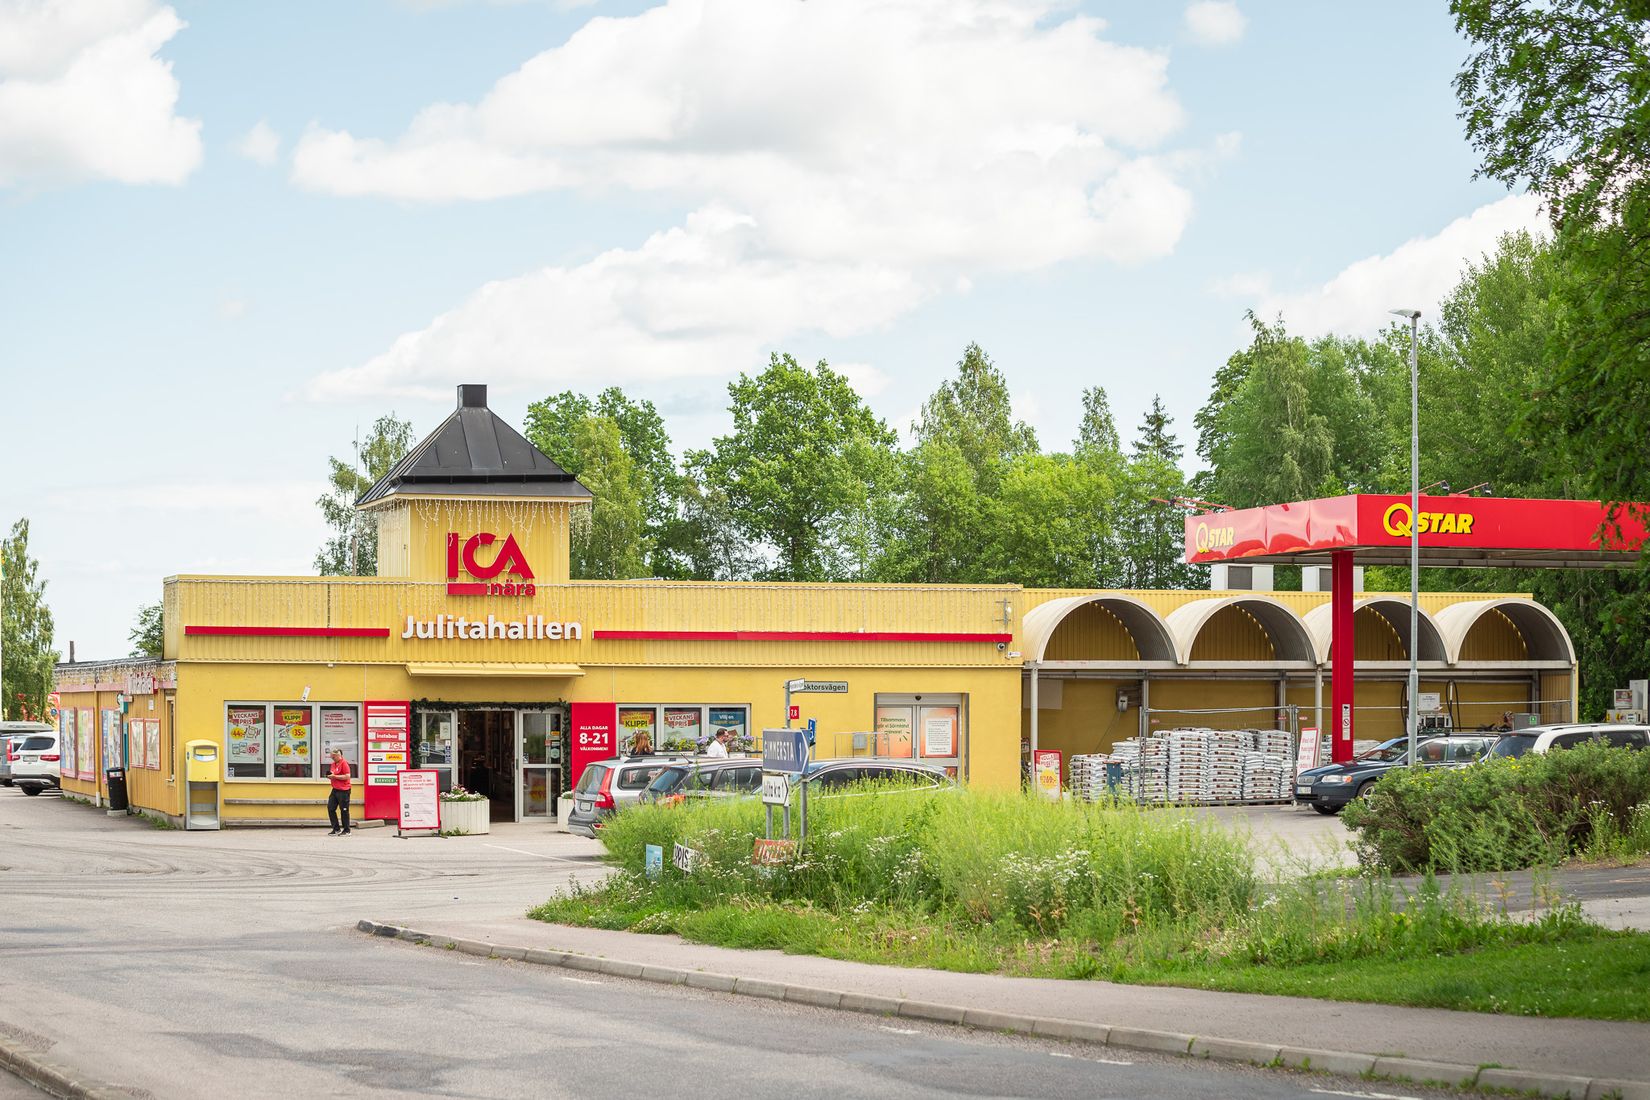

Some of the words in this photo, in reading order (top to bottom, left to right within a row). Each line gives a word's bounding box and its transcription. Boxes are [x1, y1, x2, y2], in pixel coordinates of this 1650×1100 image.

[1383, 502, 1475, 537] QSTAR
[1195, 521, 1235, 554] QSTAR
[447, 532, 535, 580] ICA
[489, 579, 536, 597] nära
[401, 614, 582, 640] Julitahallen
[579, 732, 608, 744] 8-21
[798, 742, 802, 762] 1
